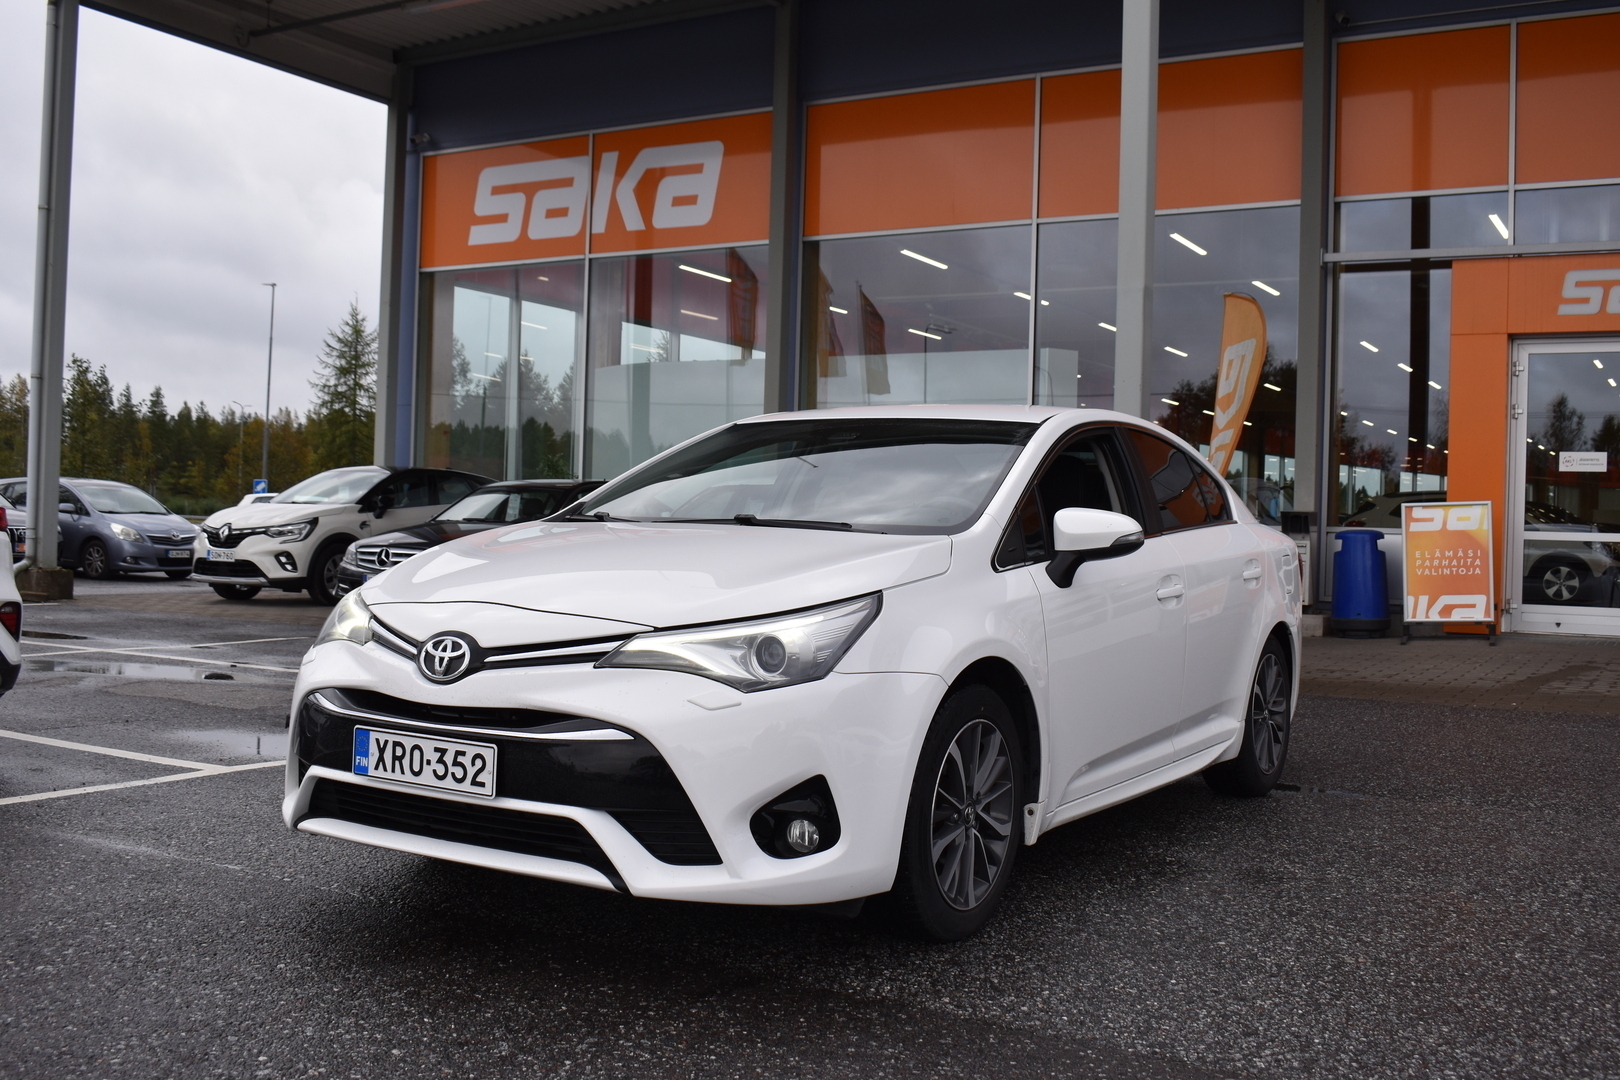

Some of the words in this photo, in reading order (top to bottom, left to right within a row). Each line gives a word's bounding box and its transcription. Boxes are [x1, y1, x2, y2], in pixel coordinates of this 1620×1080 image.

[1415, 548, 1481, 558] ELÄMÄSI
[1415, 558, 1481, 566] PARHAITA
[1415, 567, 1481, 575] VALINTOJA
[355, 756, 368, 767] FIN
[374, 737, 487, 788] XRO-352
